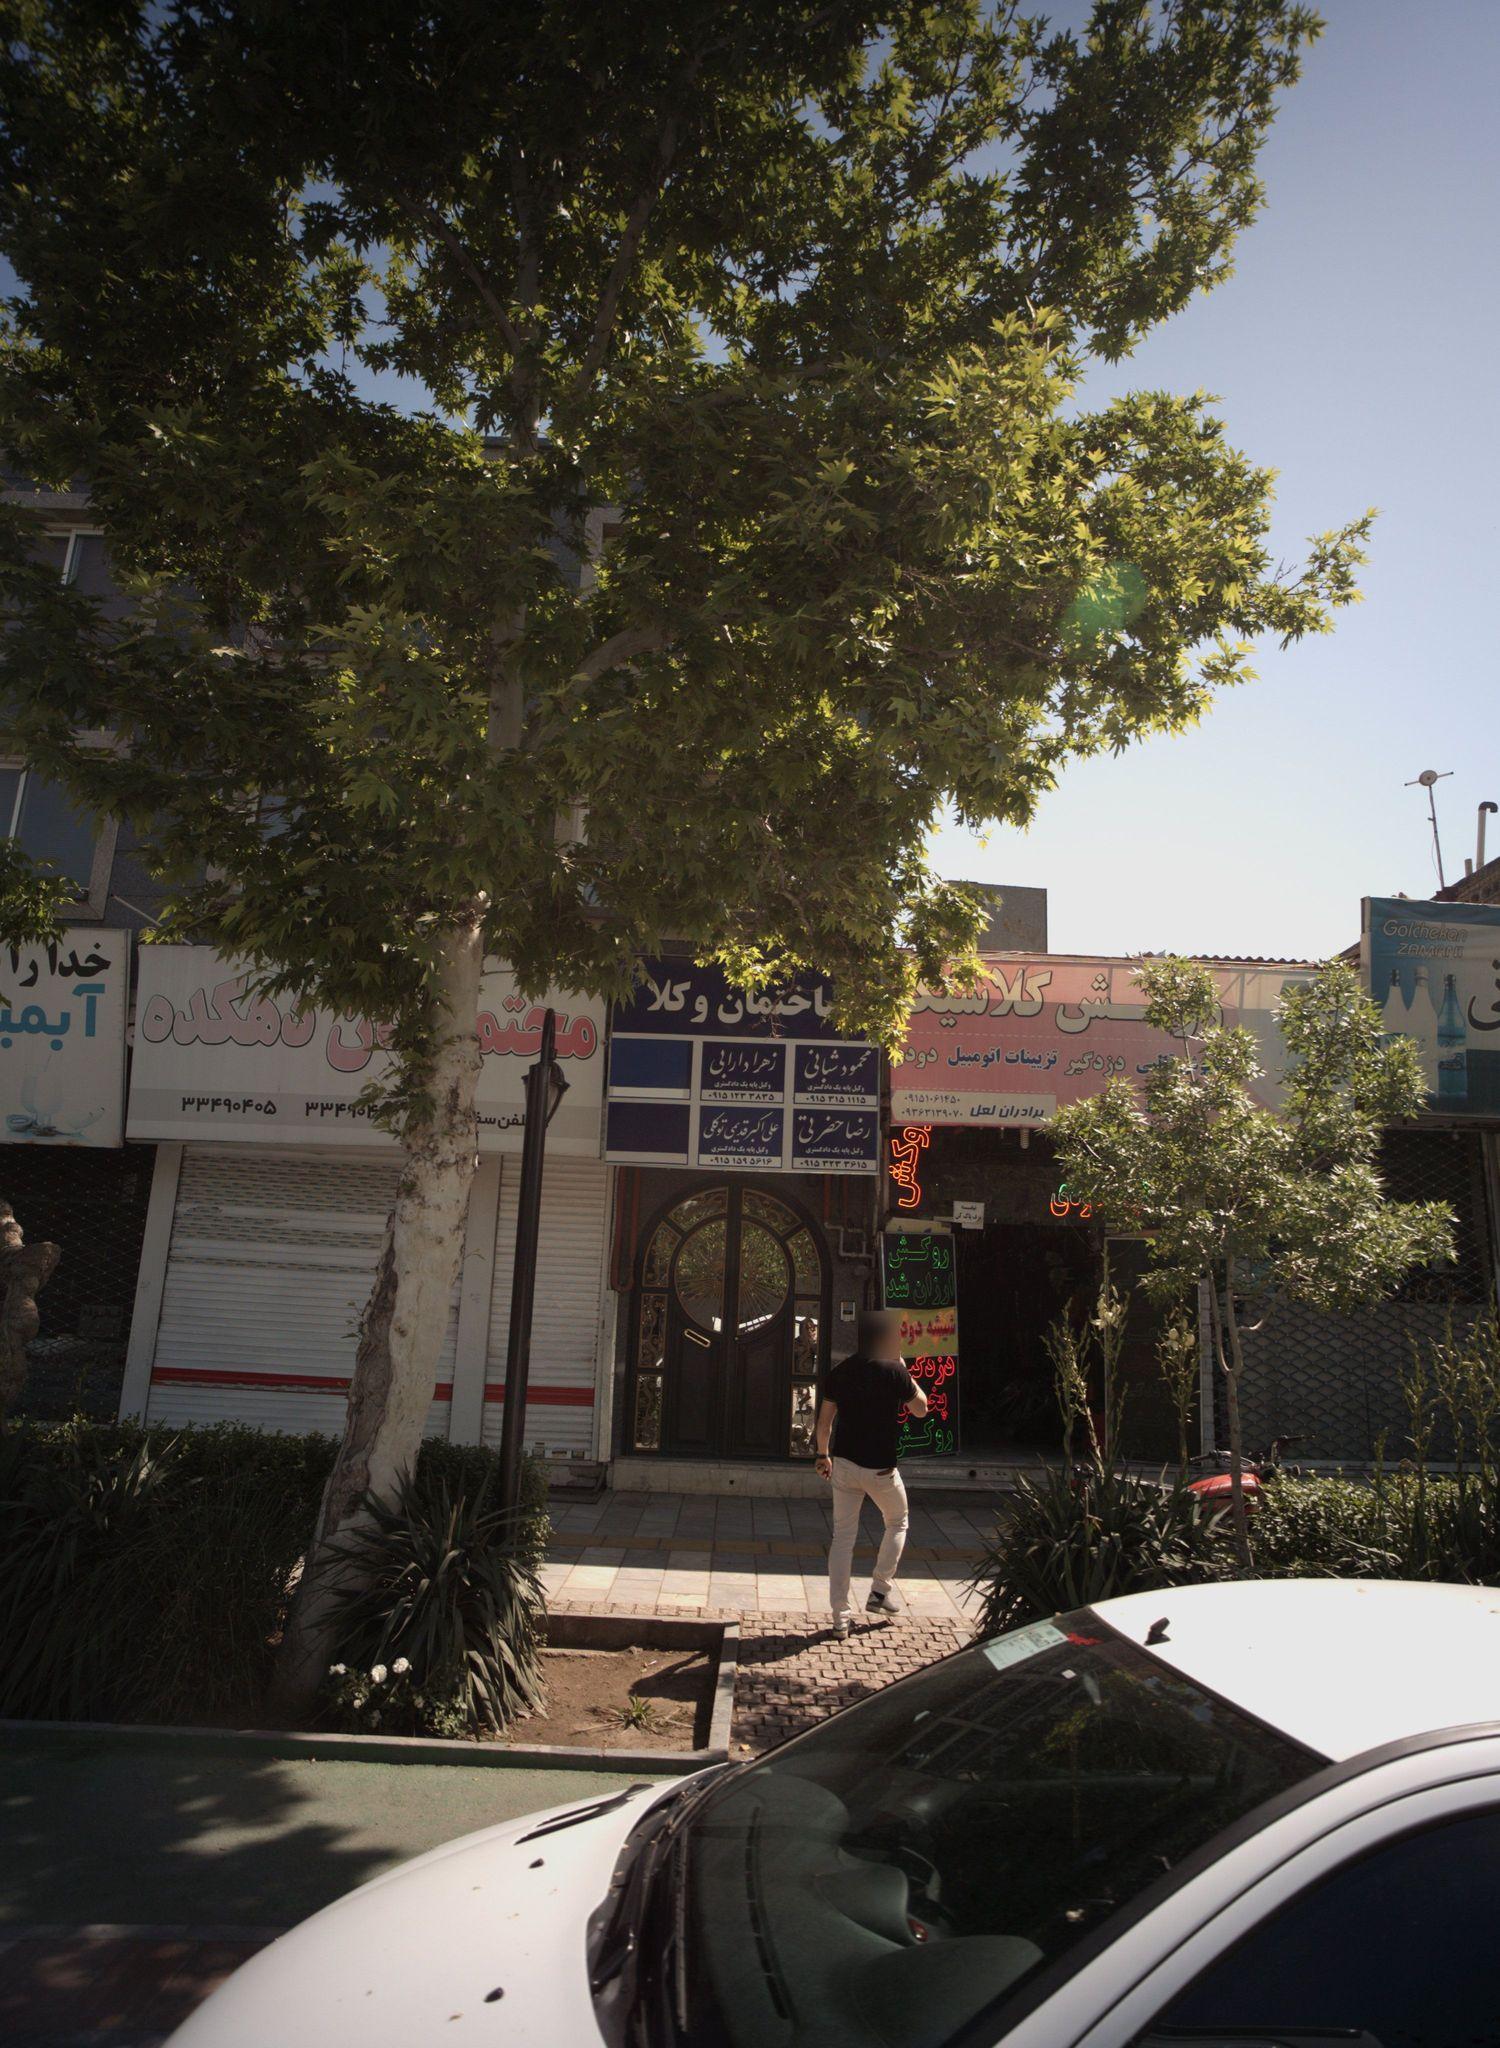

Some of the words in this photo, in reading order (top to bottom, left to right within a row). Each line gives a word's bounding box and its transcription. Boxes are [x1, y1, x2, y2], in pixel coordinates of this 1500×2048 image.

[752, 1052, 778, 1073] زهرا
[892, 1047, 938, 1069] دود
[1064, 1051, 1126, 1078] دزدگیر
[181, 1097, 277, 1115] ۳۳۴۹۰۴۰۵
[970, 1105, 996, 1118] لعل
[999, 1105, 1044, 1118] برادران
[497, 1112, 526, 1129] لفن
[798, 1114, 844, 1143] حضرتی
[846, 1117, 871, 1140] رضا
[888, 1124, 930, 1208] وکش
[888, 1236, 950, 1269] روکش
[886, 1273, 910, 1299] شد
[913, 1271, 954, 1305] ارزان
[898, 1321, 923, 1345] دود
